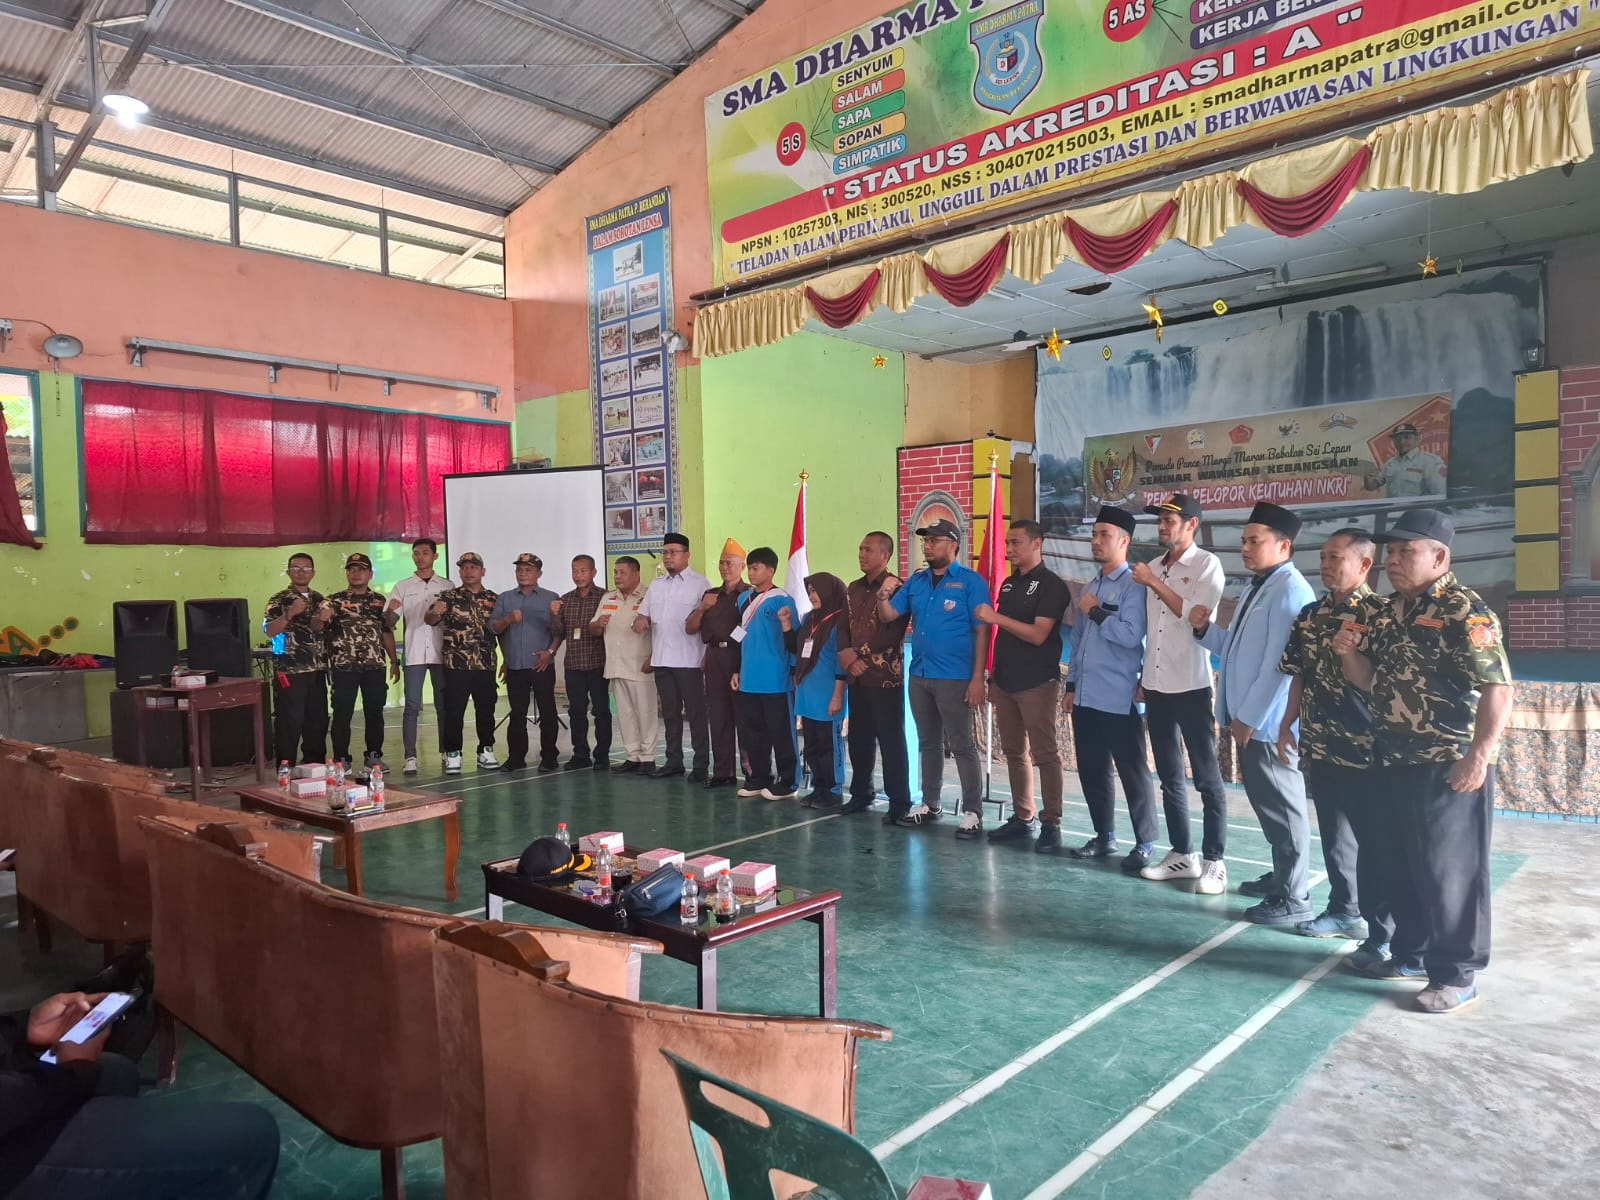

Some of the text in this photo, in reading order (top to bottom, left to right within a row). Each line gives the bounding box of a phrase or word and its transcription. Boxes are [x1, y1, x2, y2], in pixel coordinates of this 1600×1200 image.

[1199, 7, 1269, 44] KERJA
[723, 0, 959, 117] SMA DHARMA
[837, 54, 893, 87] SENYUM
[838, 80, 882, 108] SALAM
[741, 235, 772, 254] NPSN
[846, 203, 869, 220] NIS
[881, 183, 936, 209] 300520,
[941, 170, 972, 192] NSS
[986, 126, 1115, 177] 304070215003,
[1121, 103, 1184, 135] EMAIL
[1202, 0, 1558, 109] smadharmapatra@gmail.co
[838, 107, 871, 129] SAPA
[844, 143, 968, 200] STATUS
[978, 51, 1235, 158] AKREDITASI
[1282, 25, 1322, 58] A
[737, 246, 790, 275] TELADAN
[794, 231, 836, 258] DALAM
[919, 189, 985, 220] UNGGUL
[989, 166, 1049, 199] DALAM
[1054, 135, 1148, 181] PRESTASI
[1155, 120, 1198, 150] DAN
[1204, 67, 1373, 135] BERWAWASAN
[1382, 5, 1579, 83] LINGKUNGAN
[838, 124, 882, 149] SOPAN
[838, 138, 901, 170] SIMPATIK
[642, 212, 662, 232] LENSA
[1139, 457, 1358, 485] SEMINAR WAWASAN KEBANGSAAN
[1193, 486, 1246, 505] PELOPOR
[1248, 479, 1313, 502] KEUTUHAN
